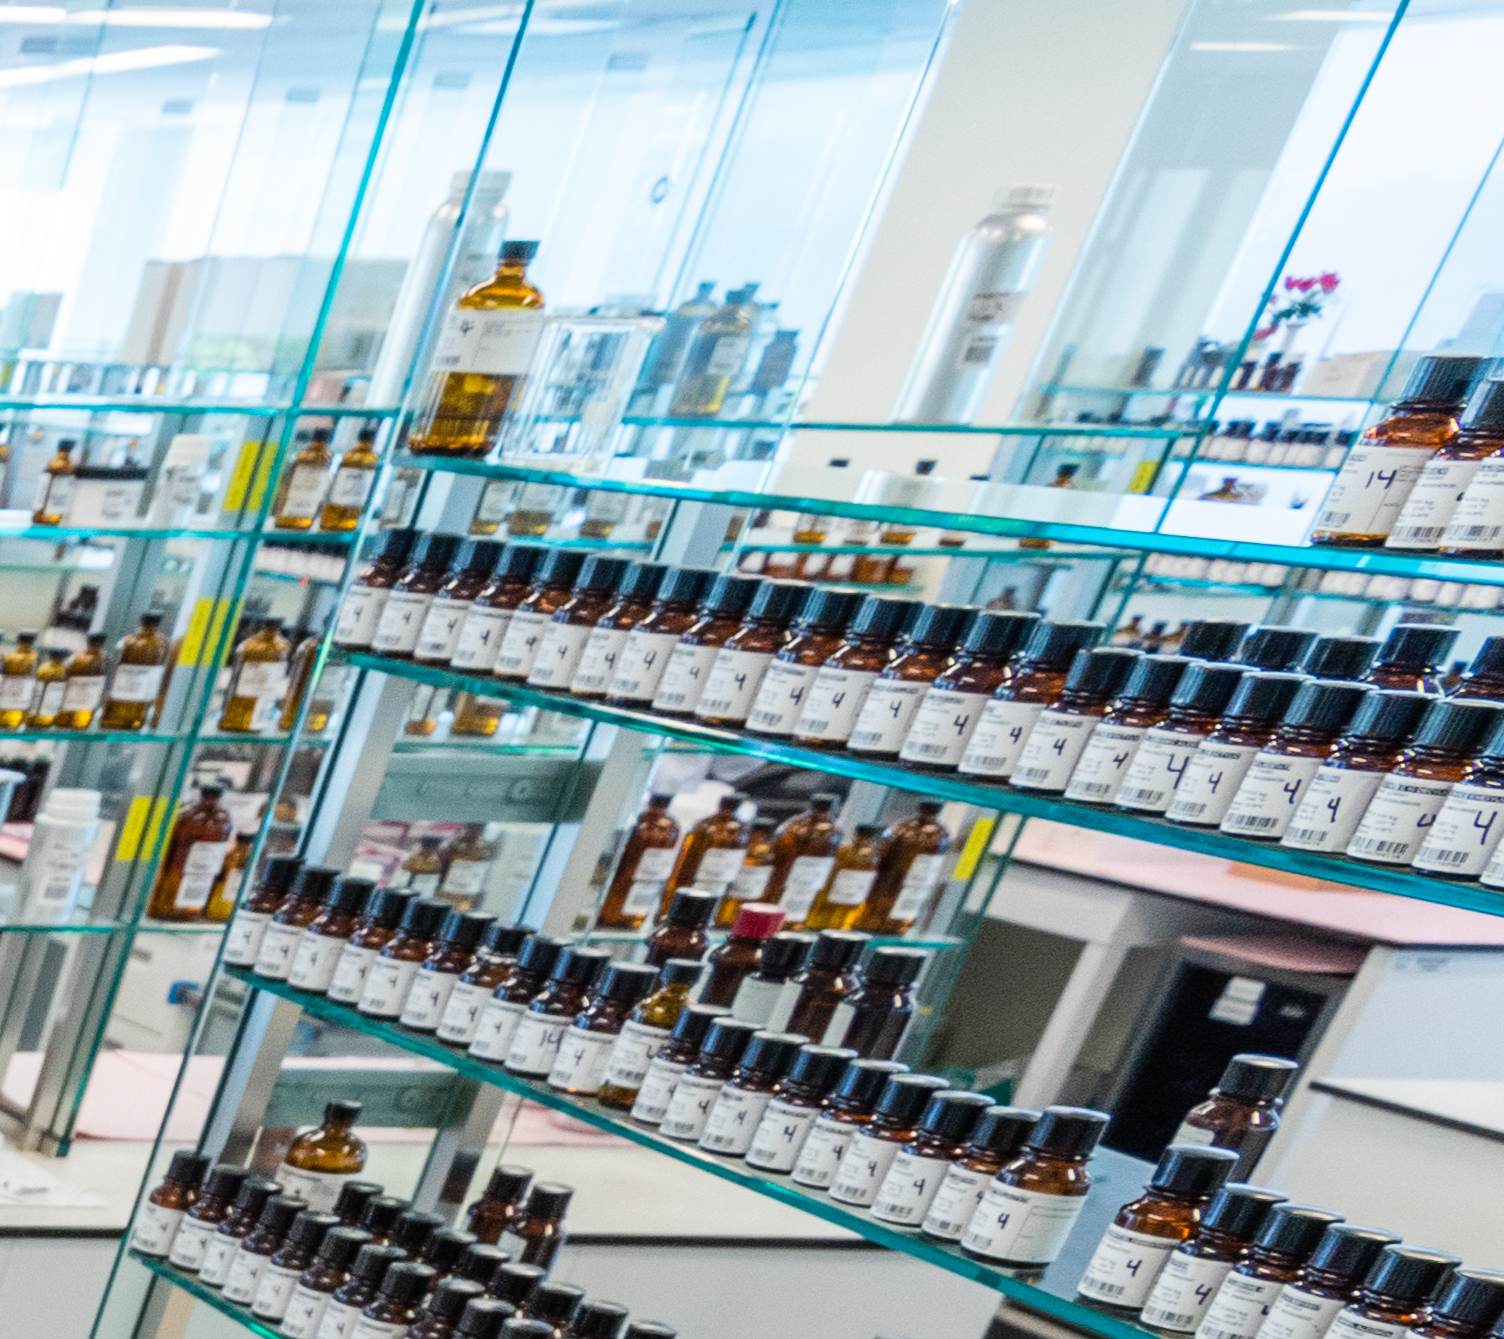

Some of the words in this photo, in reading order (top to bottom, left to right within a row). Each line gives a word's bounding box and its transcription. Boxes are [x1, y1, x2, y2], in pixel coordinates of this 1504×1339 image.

[1052, 738, 1069, 757] 4
[1113, 752, 1129, 769] 4
[1166, 753, 1190, 790] 4
[1209, 770, 1223, 793] 4
[1283, 779, 1302, 804] 4
[1327, 797, 1342, 822] 4
[1474, 810, 1497, 846] 4
